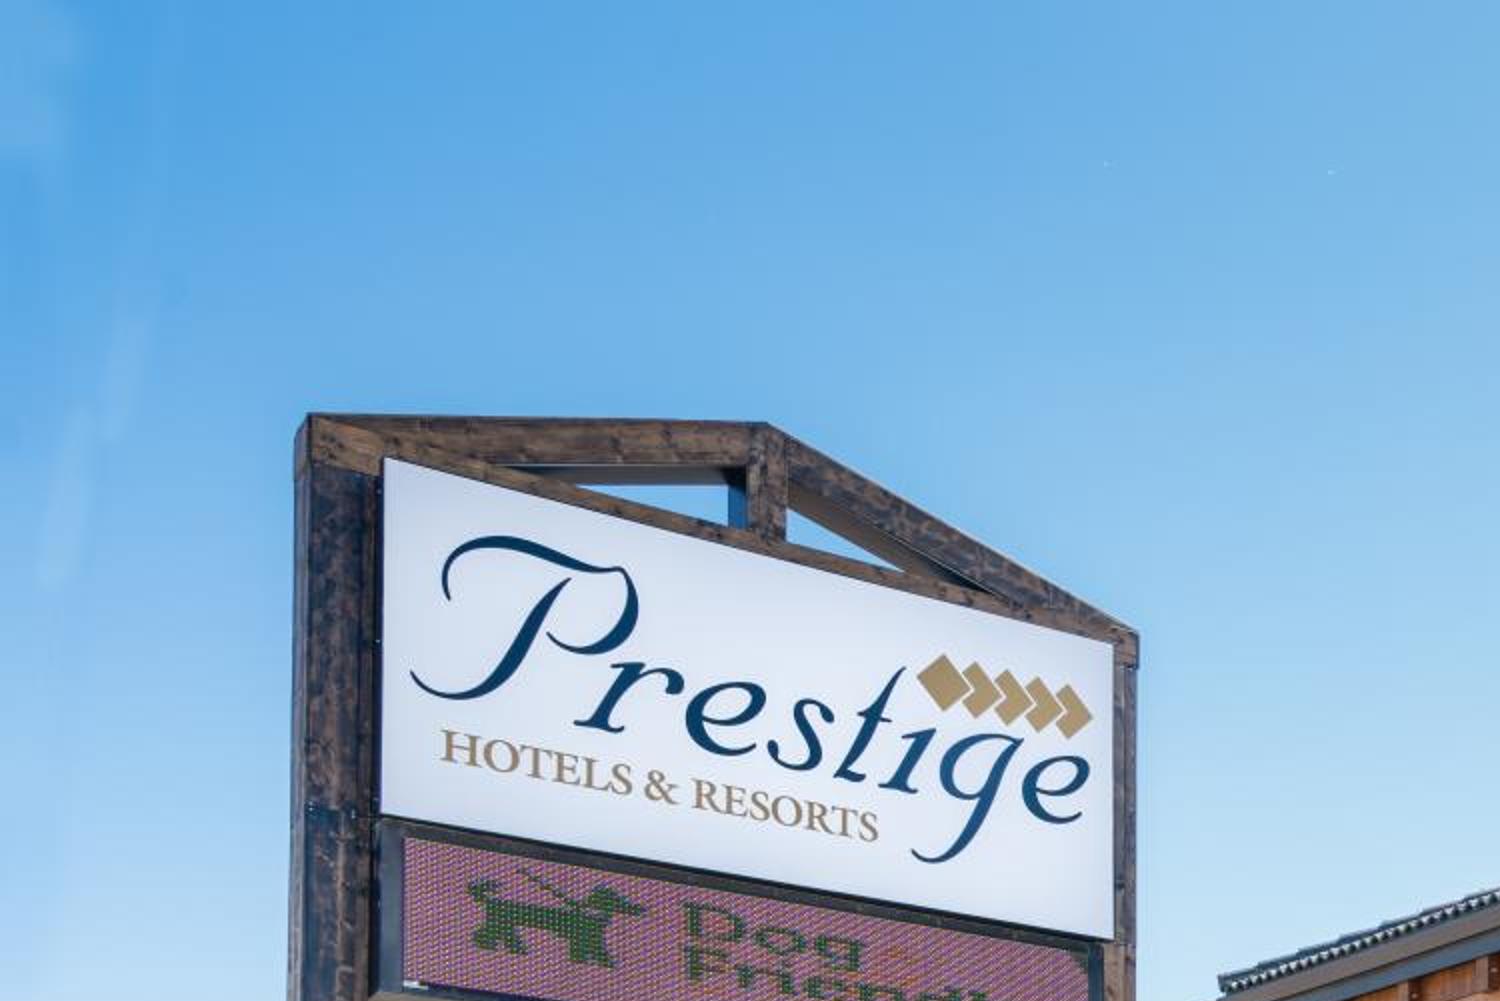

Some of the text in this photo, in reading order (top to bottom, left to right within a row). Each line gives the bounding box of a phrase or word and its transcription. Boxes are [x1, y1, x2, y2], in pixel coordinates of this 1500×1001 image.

[410, 535, 1092, 865] Prestige
[440, 728, 880, 843] HOTELS & RESORTS
[683, 901, 865, 974] Dog
